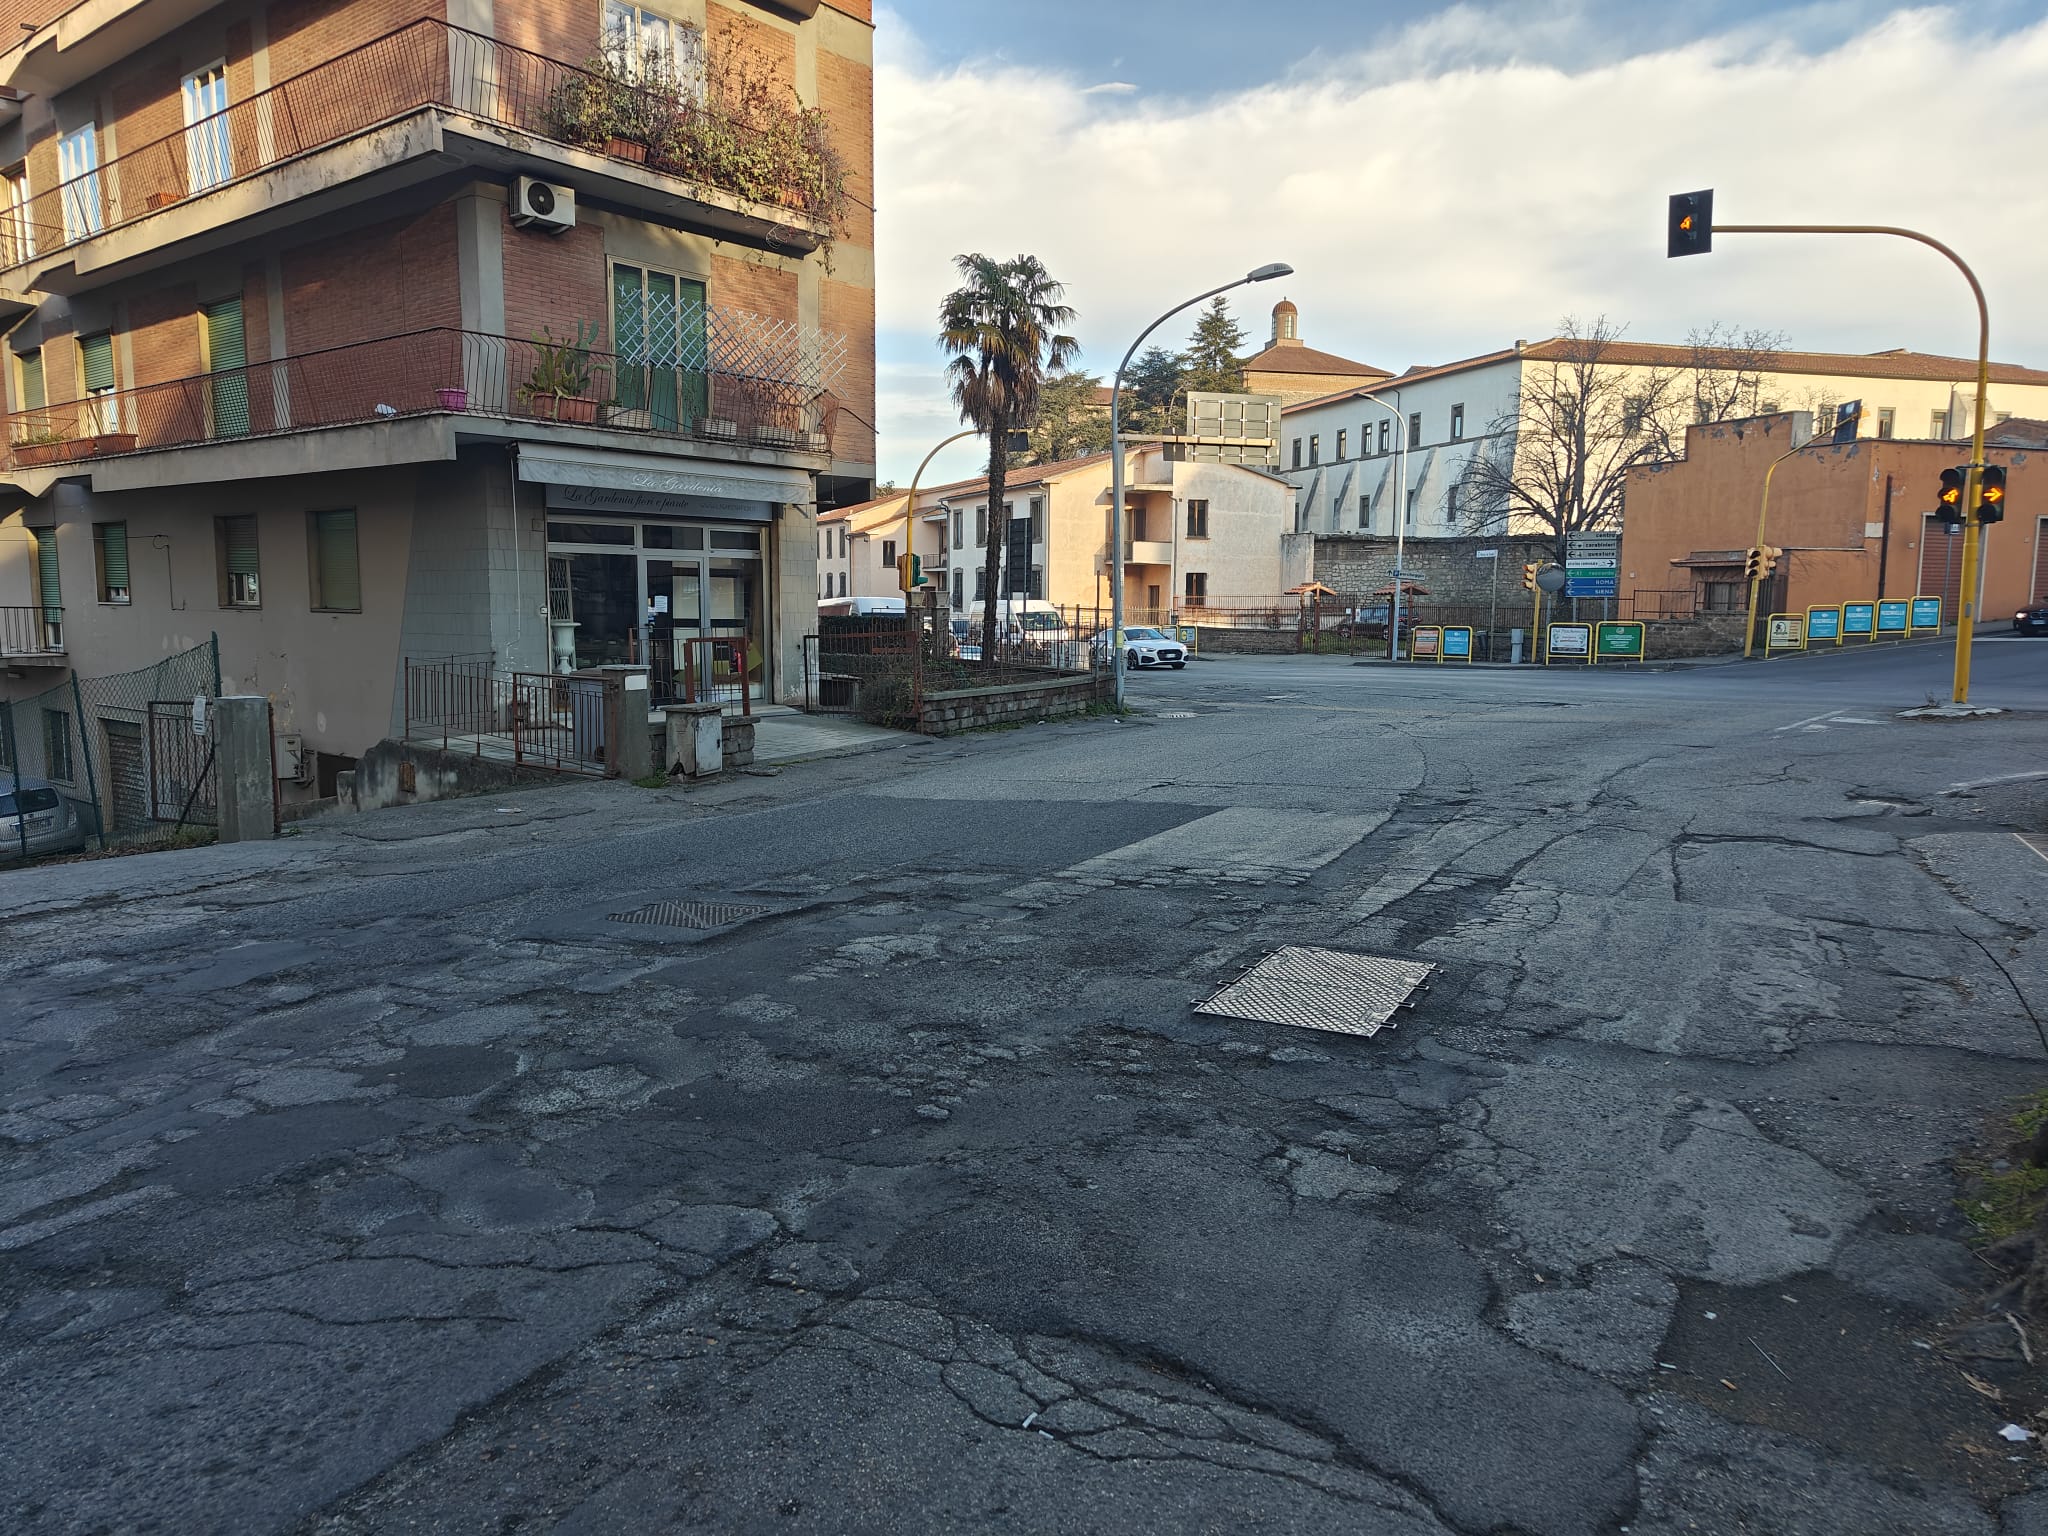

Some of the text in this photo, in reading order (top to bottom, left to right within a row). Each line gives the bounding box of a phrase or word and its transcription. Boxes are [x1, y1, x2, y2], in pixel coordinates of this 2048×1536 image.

[631, 473, 722, 493] La Gardenia
[564, 486, 581, 501] La
[584, 487, 633, 505] Gardenia
